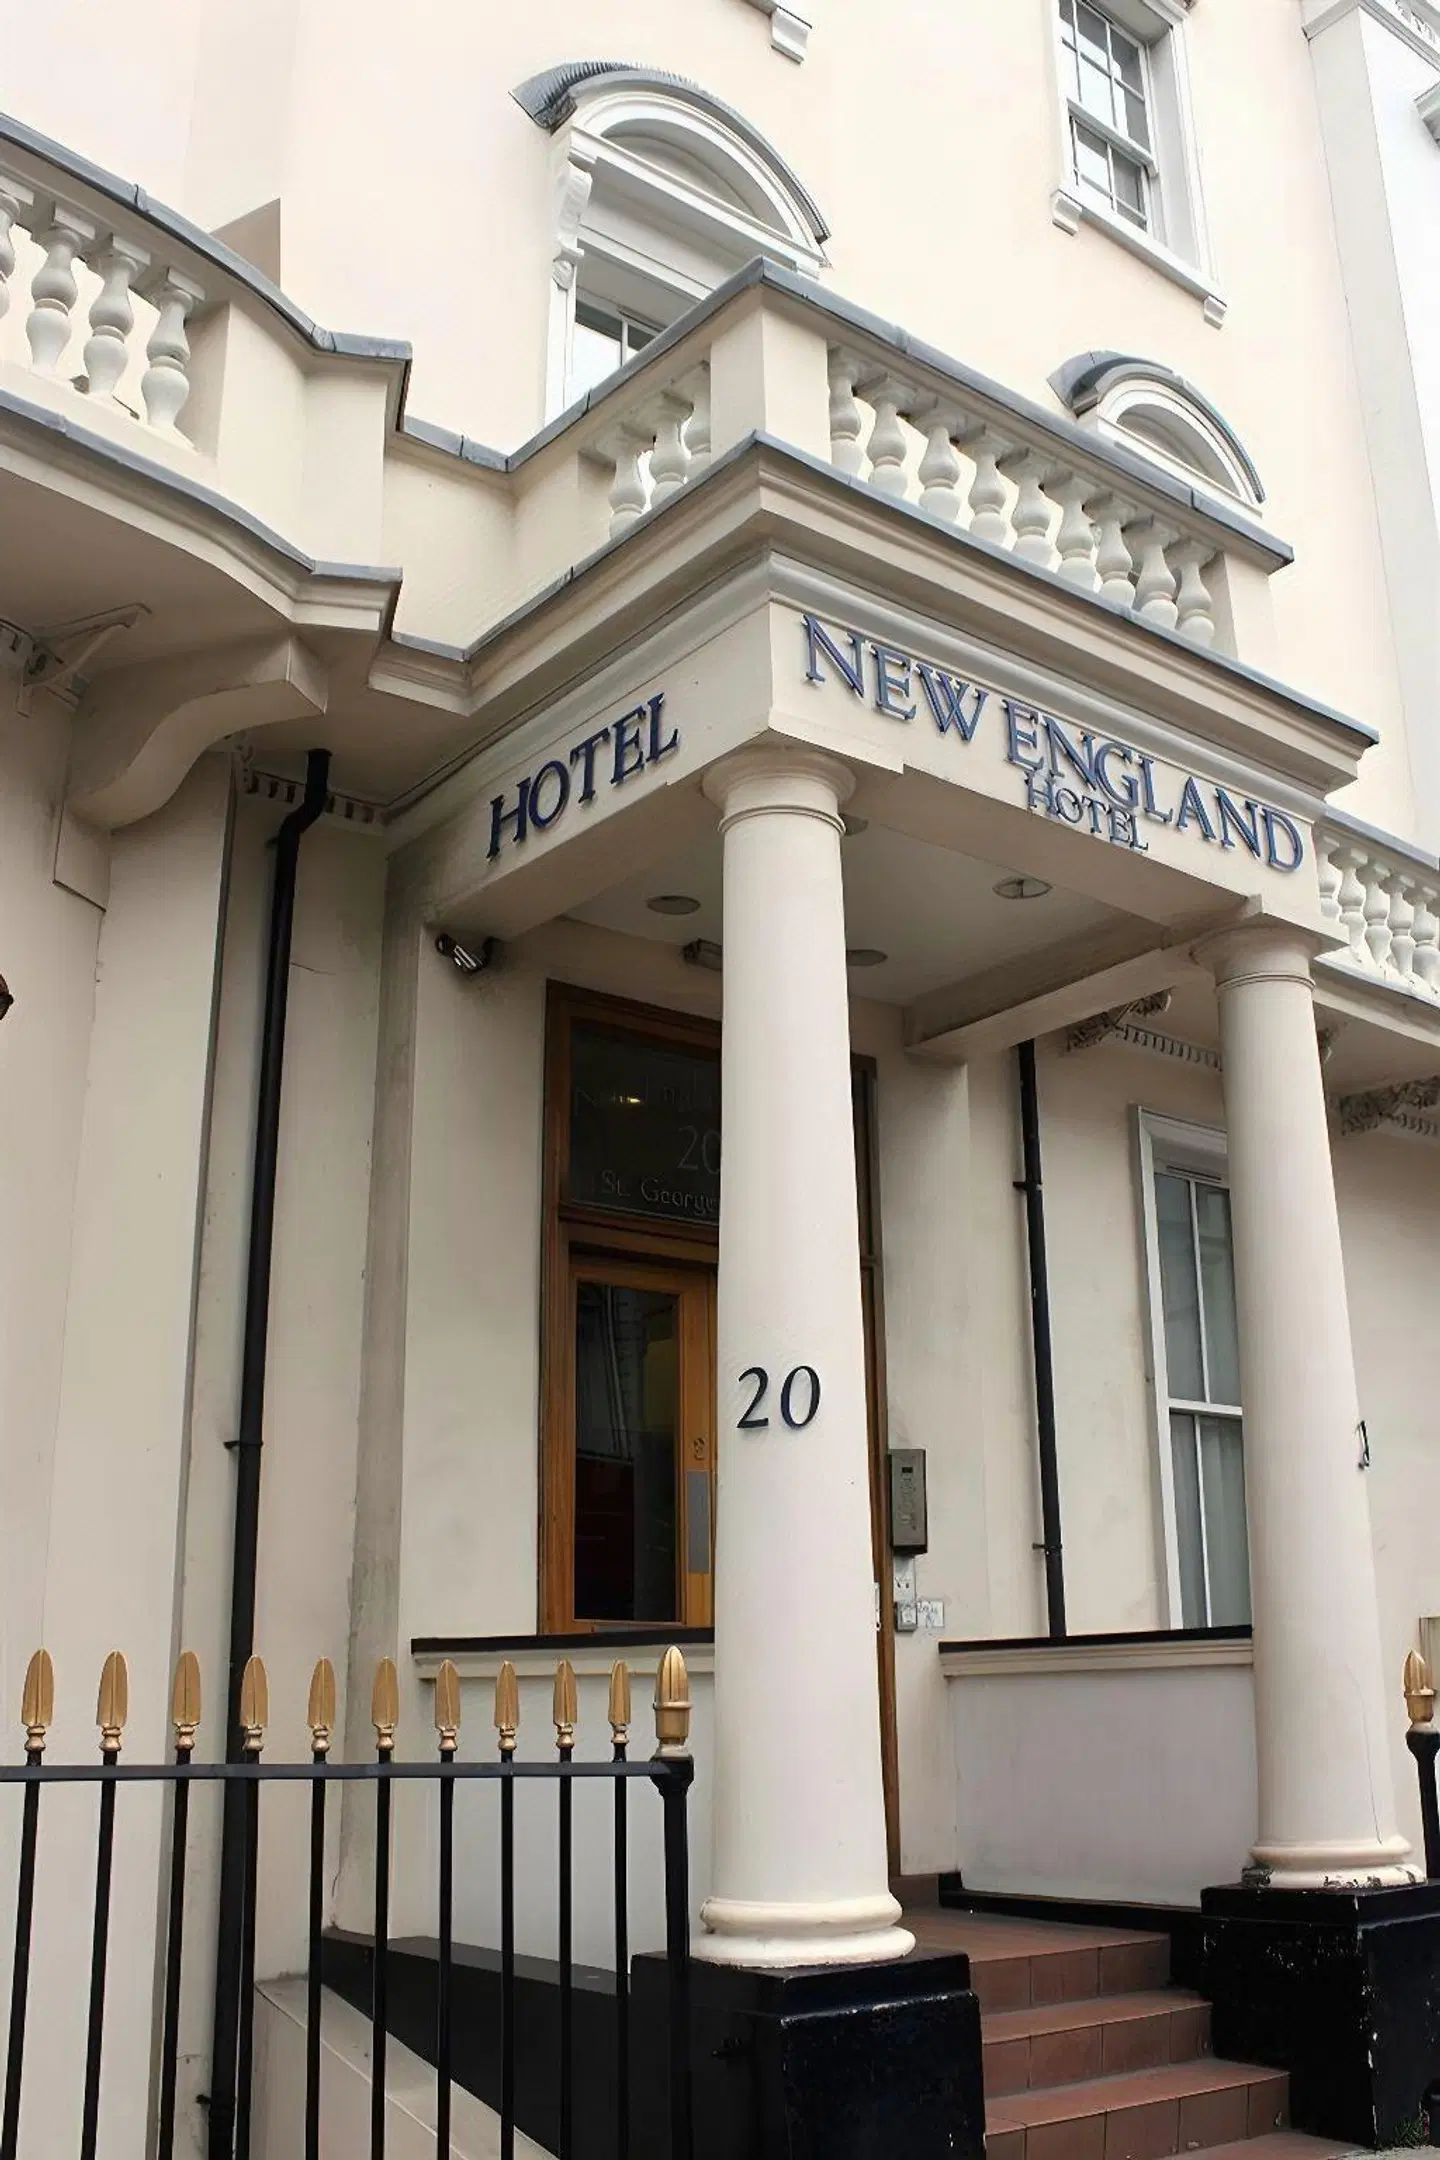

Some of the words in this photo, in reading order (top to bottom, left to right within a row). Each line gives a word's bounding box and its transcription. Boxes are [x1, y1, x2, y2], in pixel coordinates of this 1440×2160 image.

[486, 692, 679, 861] HOTEL
[801, 614, 989, 742] NEW
[1003, 699, 1304, 872] ENGLAND
[1024, 770, 1149, 850] HOTEL
[737, 1366, 820, 1429] 20
